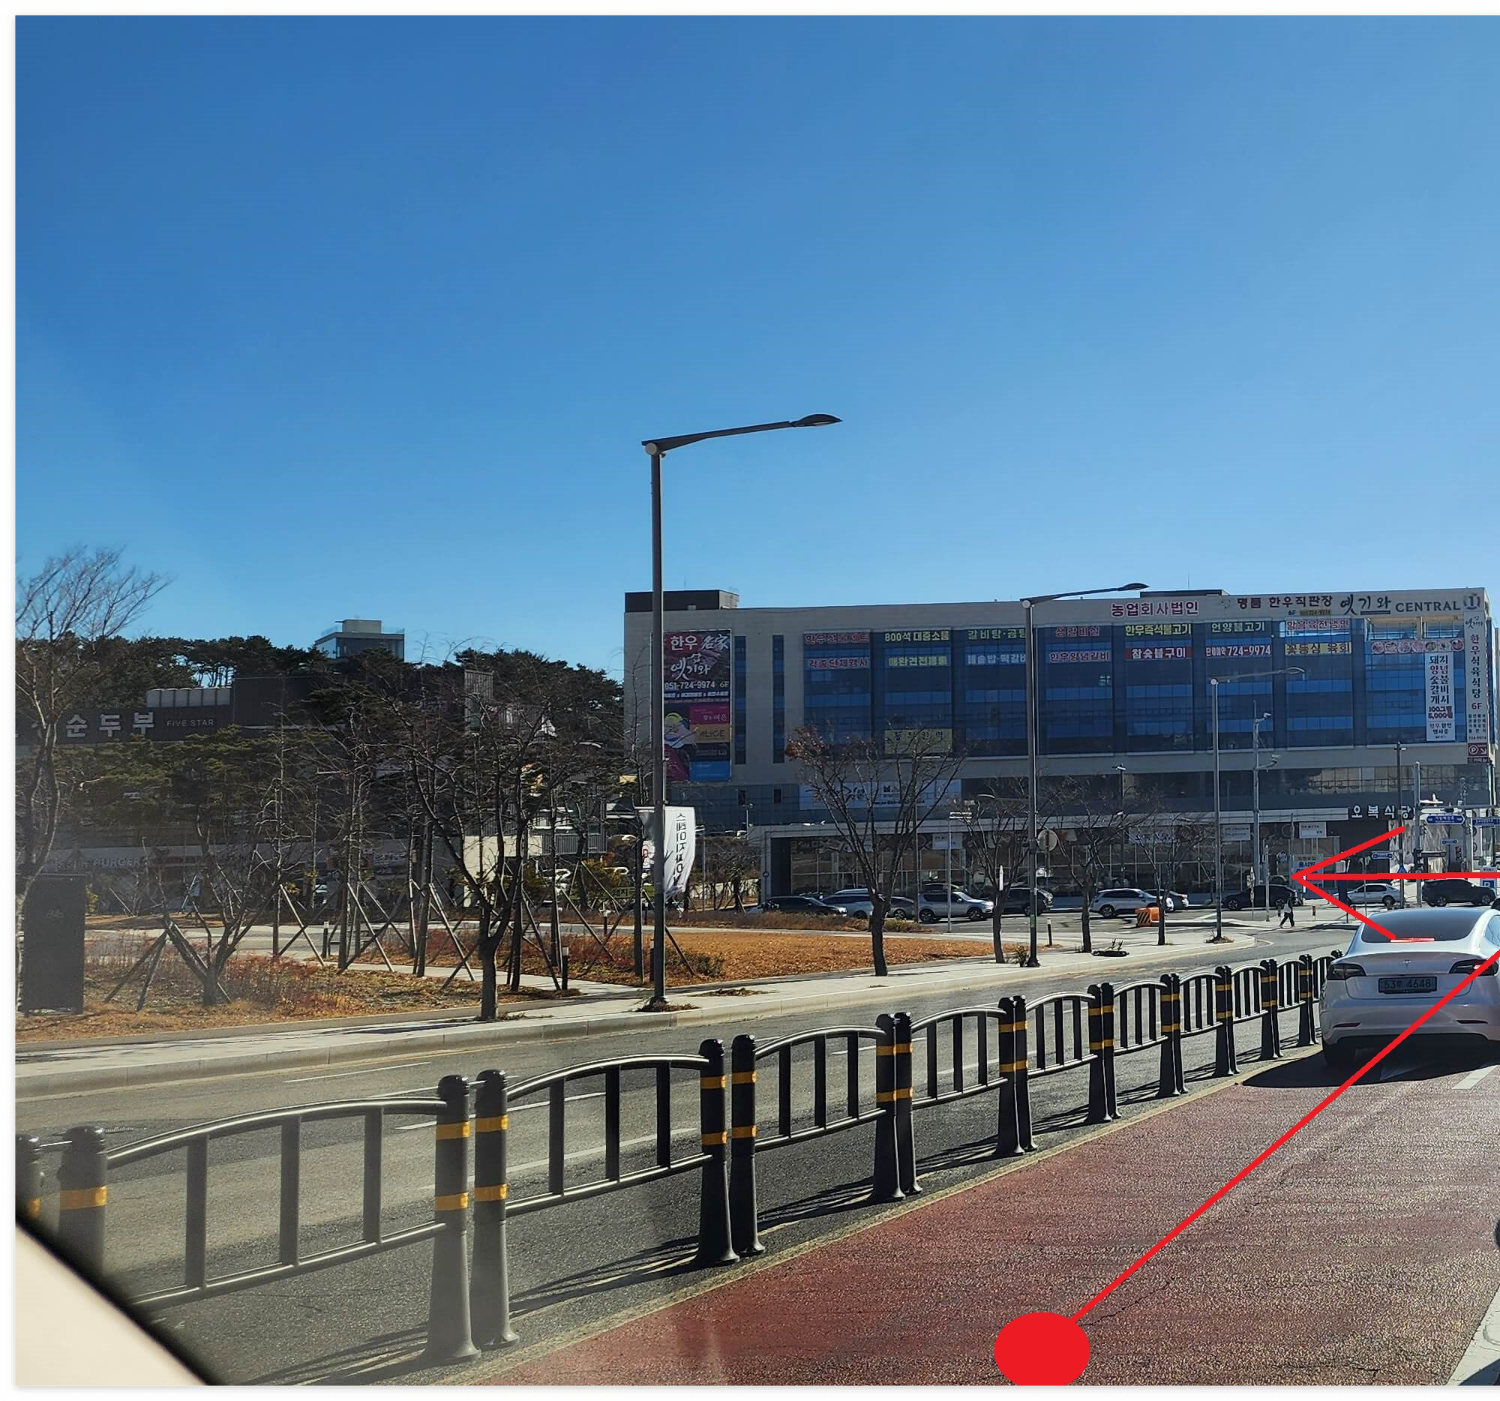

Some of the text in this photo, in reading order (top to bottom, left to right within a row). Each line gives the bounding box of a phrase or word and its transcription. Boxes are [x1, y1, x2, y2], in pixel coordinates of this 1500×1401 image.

[1237, 595, 1333, 609] 명품 한우직판장
[1395, 601, 1461, 613] CENTRAL
[1111, 601, 1199, 617] 농업회사법인
[1125, 624, 1192, 636] 한우즉석불고기
[1211, 622, 1265, 633] 언양불고기
[670, 635, 698, 651] 한우
[884, 632, 911, 642] 800석
[1131, 647, 1186, 659] 참숯불구이
[1227, 644, 1271, 656] 724-9974
[1328, 642, 1350, 654] 육회
[1429, 655, 1449, 665] 돼지
[1430, 665, 1449, 675] 양념
[1470, 634, 1481, 699] 한우식육식당
[664, 681, 715, 690] 051-724-9974
[1430, 685, 1449, 695] 갈비
[1471, 702, 1482, 710] 6F
[166, 719, 214, 727] FIVE STAR
[1351, 805, 1413, 819] 오복식당
[1406, 979, 1432, 988] 4648
